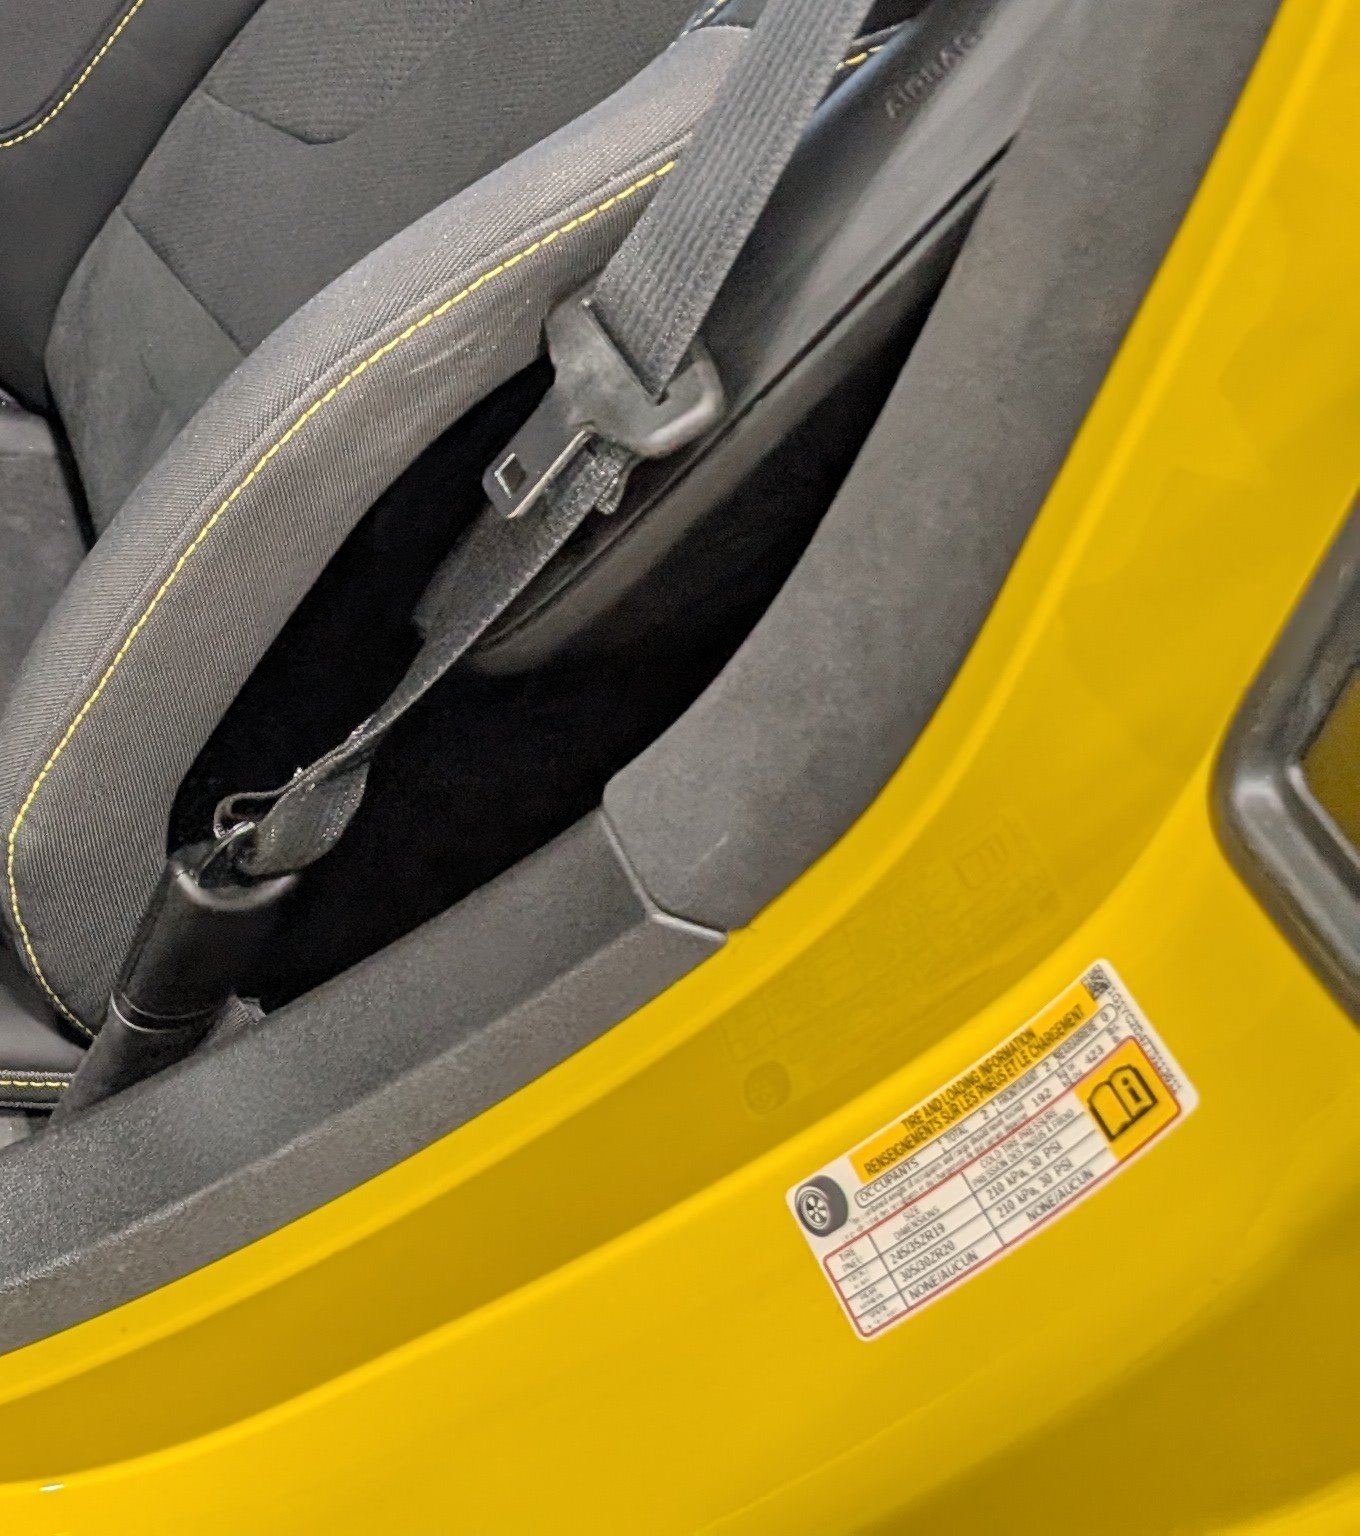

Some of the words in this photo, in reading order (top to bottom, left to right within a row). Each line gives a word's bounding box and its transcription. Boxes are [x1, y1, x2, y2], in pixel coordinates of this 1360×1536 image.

[862, 1114, 944, 1176] RENSEIGNEMENTS
[939, 1102, 961, 1124] SUR
[958, 1089, 979, 1111] LES
[975, 1068, 1007, 1098] PNEUS
[1025, 1003, 1085, 1059] CHARGEMENT
[900, 1109, 924, 1131] TIRE
[920, 1095, 944, 1118] AND
[939, 1069, 981, 1105] LOADING
[978, 1026, 1035, 1077] INFORMATION
[1031, 1086, 1052, 1107] 192
[858, 1156, 919, 1202] OCCUPANTS
[985, 1180, 1006, 1200] 210
[1041, 1139, 1063, 1159] PSI
[995, 1198, 1016, 1218] 210
[1052, 1156, 1073, 1176] PSI
[1025, 1167, 1094, 1221] NONE/AUCUN
[888, 1221, 946, 1264] 245/35ZR19
[907, 1248, 979, 1300] NONE/AUCUN
